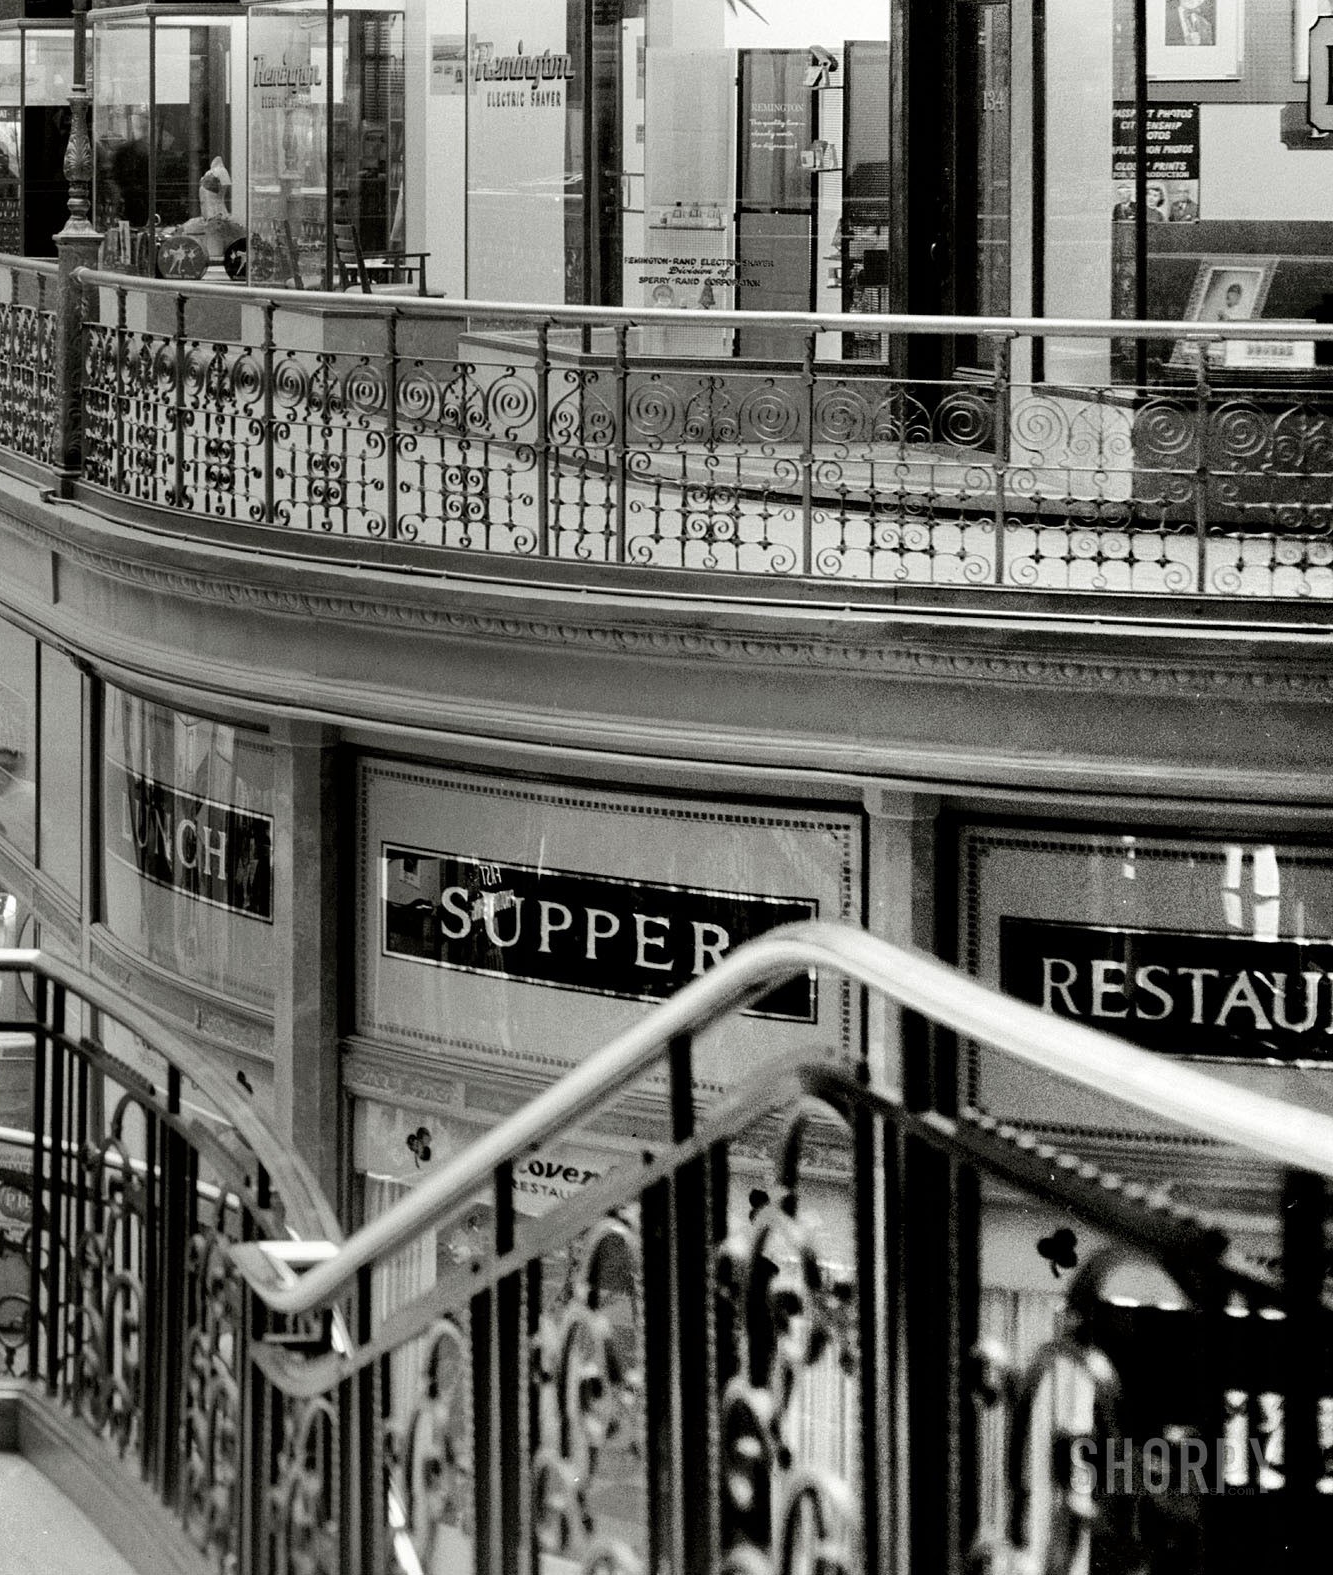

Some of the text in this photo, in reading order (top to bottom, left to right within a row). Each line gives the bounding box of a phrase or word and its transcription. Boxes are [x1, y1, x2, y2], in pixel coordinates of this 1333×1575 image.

[474, 39, 576, 90] Remington
[487, 90, 561, 107] ELECTRIC SHAVER
[1152, 161, 1187, 170] PRINTS
[668, 266, 731, 276] Division of
[638, 276, 700, 285] SPERRY-RAND
[122, 791, 227, 881] LUNCH
[441, 886, 731, 976] SUPPER
